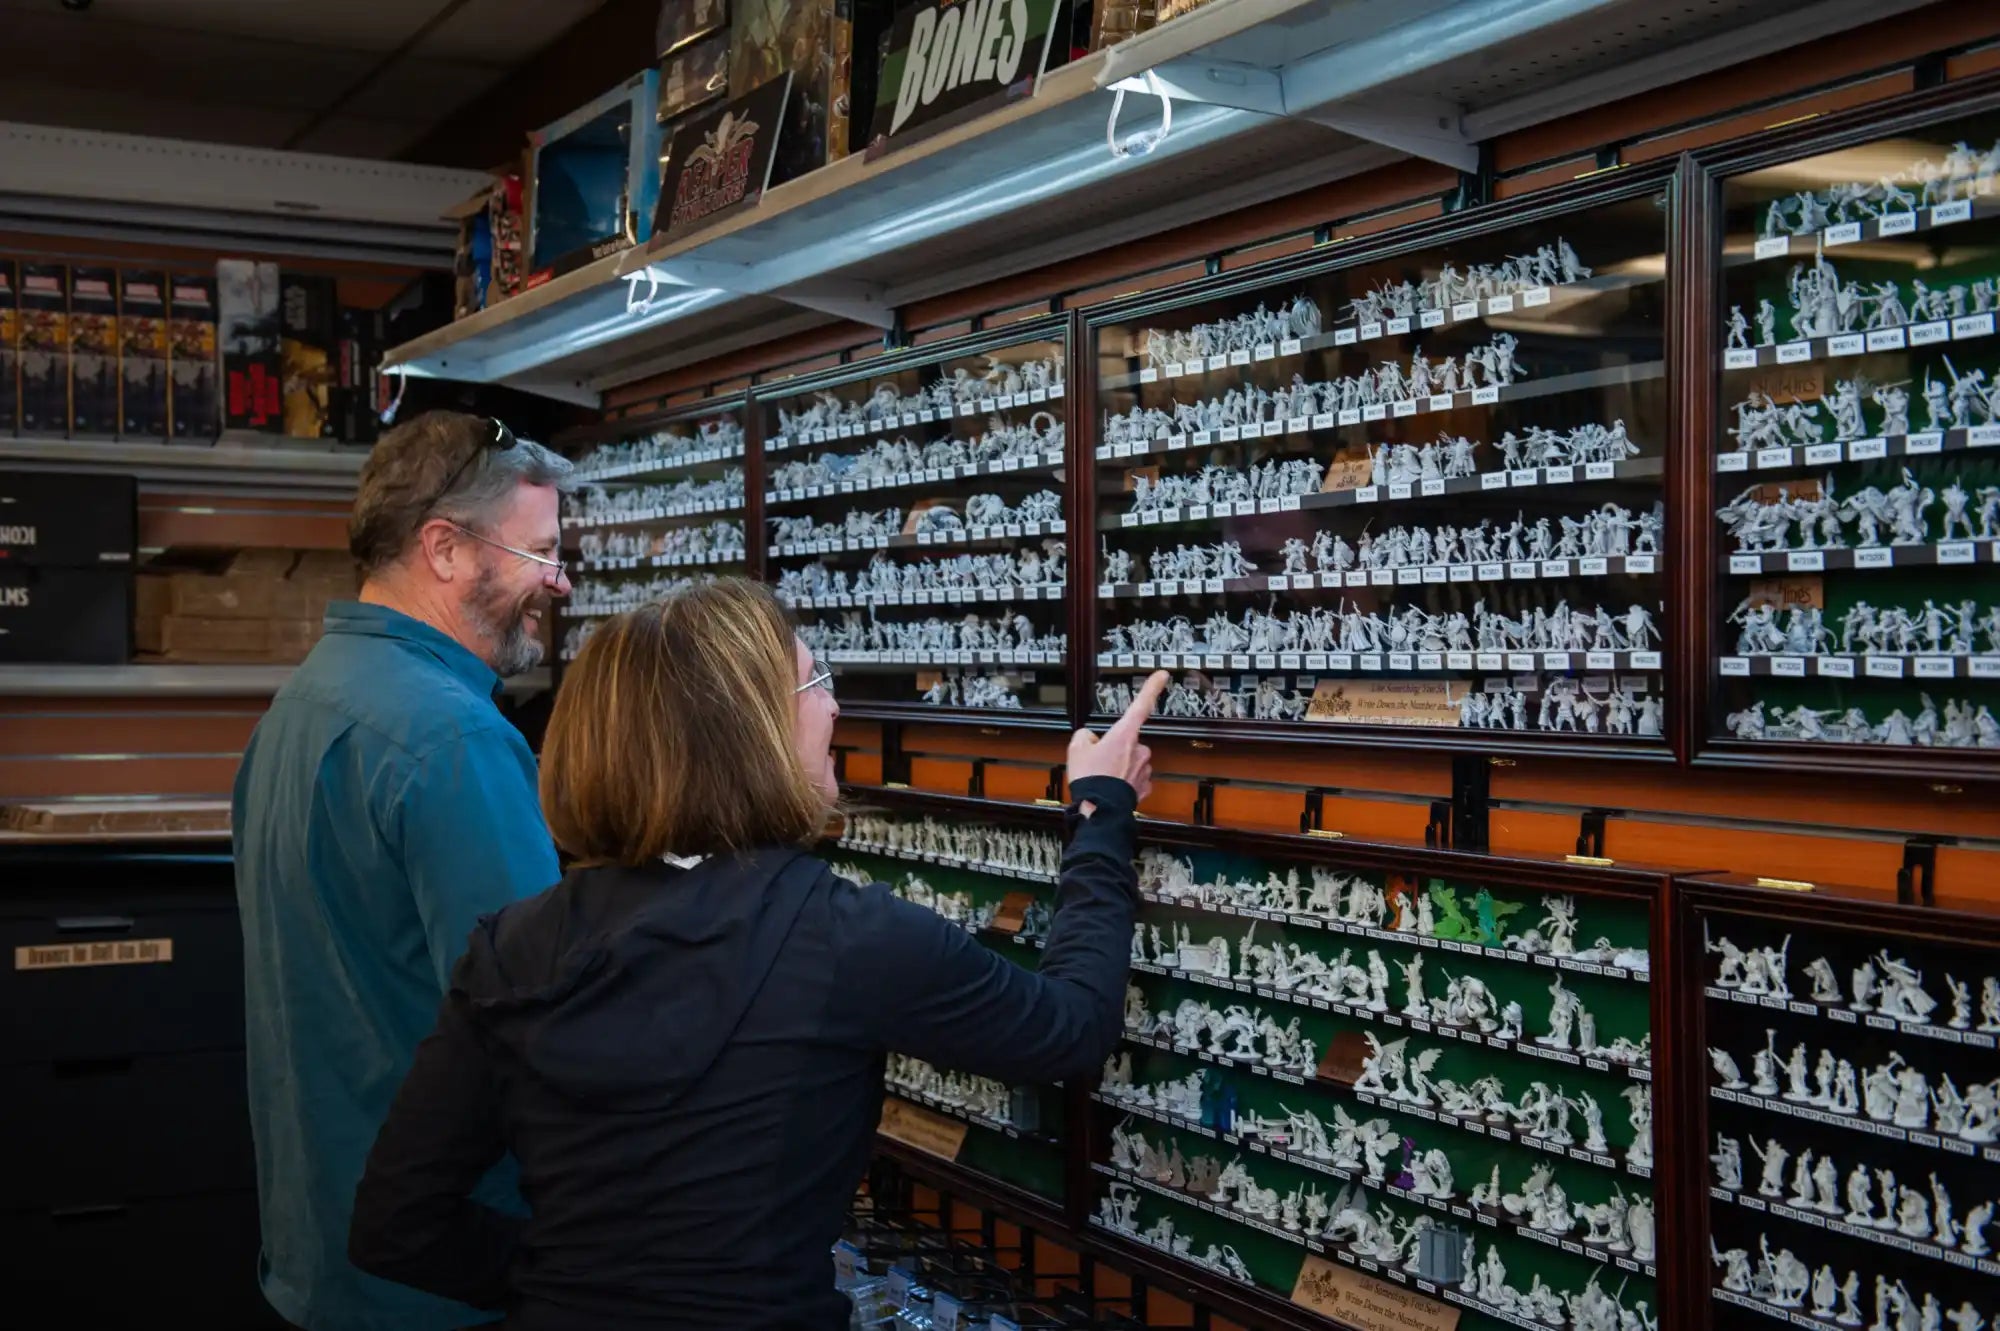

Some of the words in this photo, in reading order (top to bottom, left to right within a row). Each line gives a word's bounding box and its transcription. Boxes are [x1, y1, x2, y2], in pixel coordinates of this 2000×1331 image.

[889, 0, 1028, 136] BONES
[675, 137, 754, 207] REAPER
[1376, 699, 1395, 708] Down
[1397, 700, 1408, 710] the
[1410, 700, 1436, 710] Number
[1346, 1291, 1363, 1306] Write
[1364, 1299, 1382, 1315] Down
[1384, 1308, 1396, 1318] the
[1397, 1311, 1424, 1329] Number
[1425, 1323, 1440, 1331] and
[1374, 1284, 1408, 1308] Something
[1411, 1296, 1425, 1309] You
[1336, 1307, 1352, 1320] Staff
